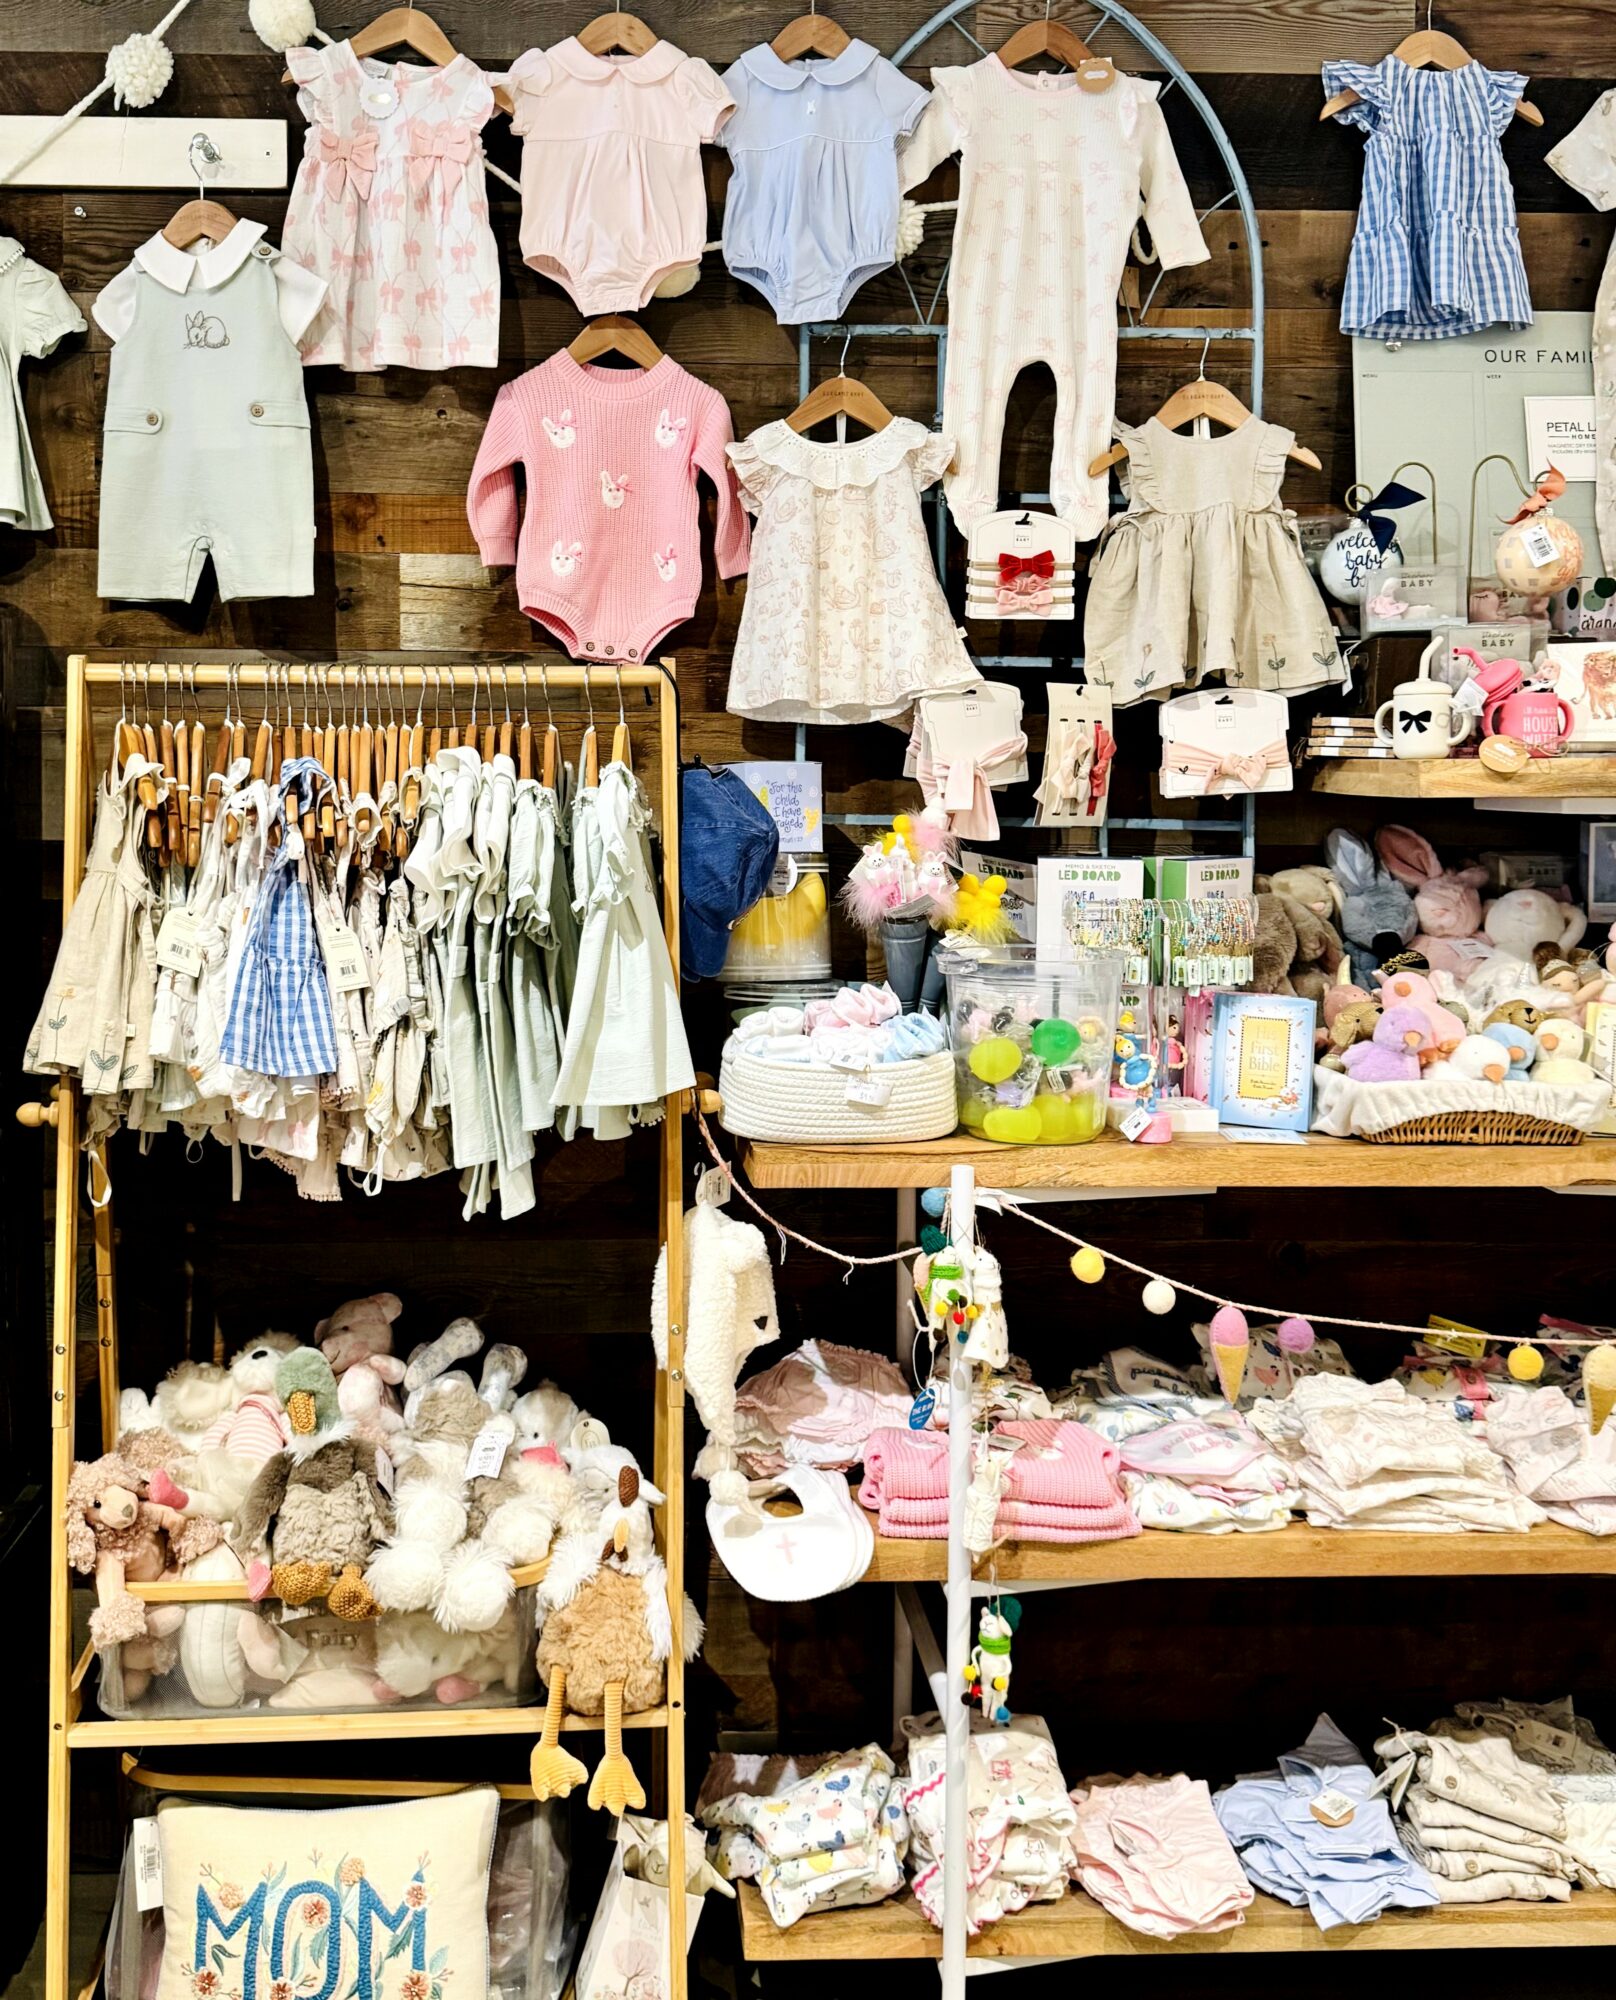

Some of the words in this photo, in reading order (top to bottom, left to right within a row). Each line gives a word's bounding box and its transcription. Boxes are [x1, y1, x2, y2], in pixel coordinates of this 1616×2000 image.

[1484, 349, 1527, 363] OUR
[1546, 422, 1584, 433] PETAL
[1345, 550, 1387, 569] baby
[1401, 579, 1434, 587] BABY
[1482, 639, 1515, 647] BABY
[1523, 716, 1558, 733] HOUSE
[782, 807, 802, 818] have
[978, 863, 993, 875] LED
[1059, 870, 1078, 880] LED
[1083, 870, 1121, 881] BOARD
[1200, 871, 1213, 881] LED
[1216, 869, 1239, 880] BOARD
[1250, 1041, 1280, 1056] First
[1249, 1056, 1280, 1072] Bible
[306, 1628, 360, 1651] Fairy
[195, 1870, 428, 2000] MOM
